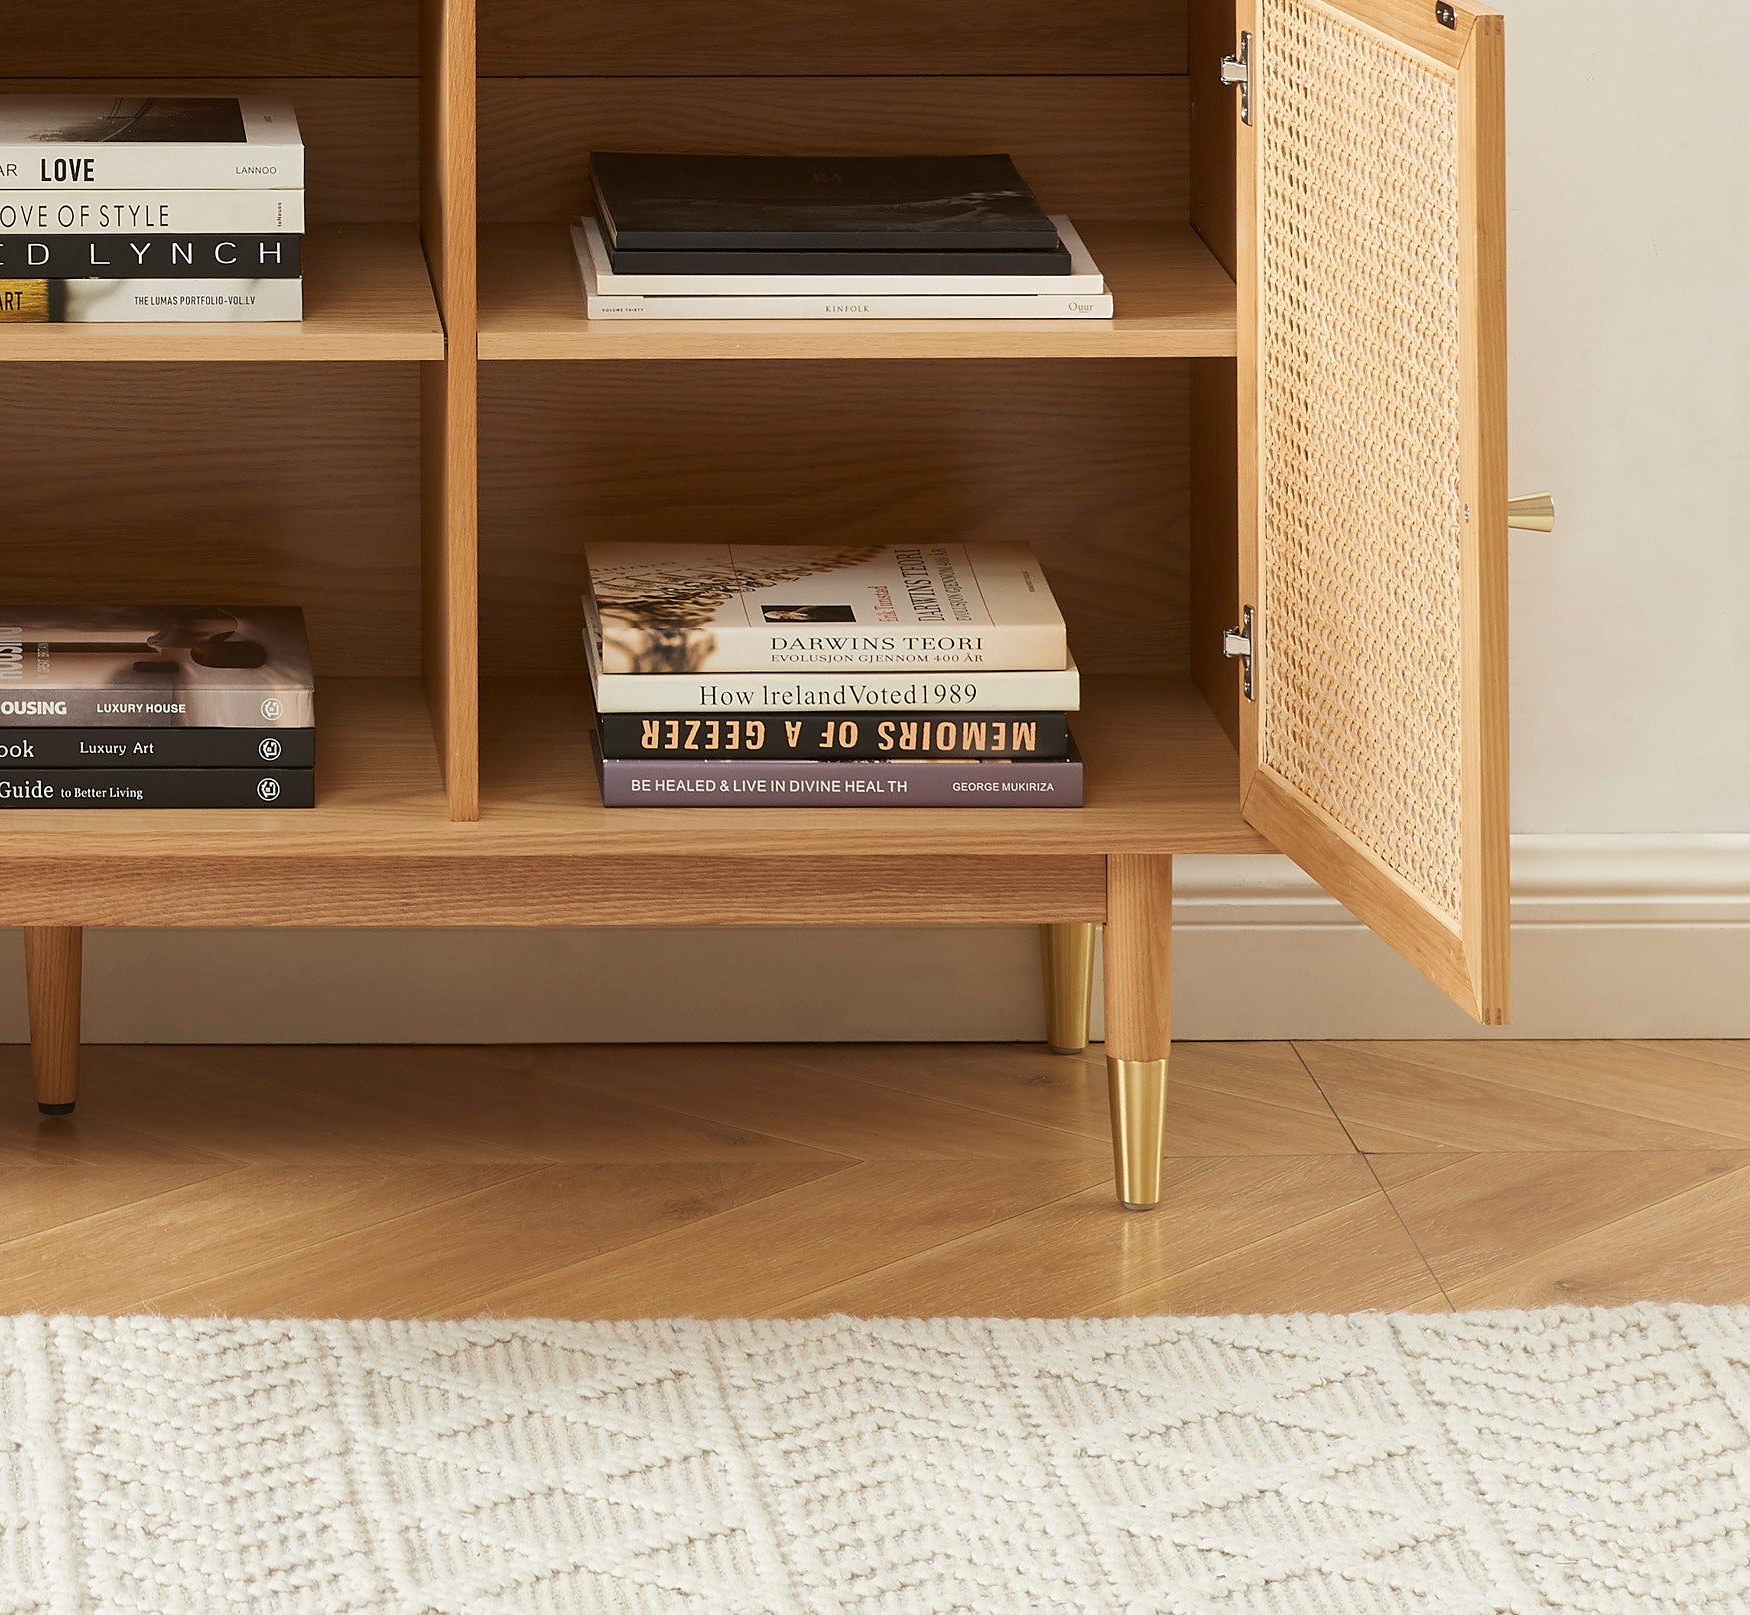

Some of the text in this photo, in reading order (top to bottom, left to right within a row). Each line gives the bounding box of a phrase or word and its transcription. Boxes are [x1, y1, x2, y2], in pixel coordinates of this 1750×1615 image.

[41, 158, 95, 182] LOVE
[235, 166, 277, 175] LANNOO
[57, 204, 90, 228] OF
[99, 204, 169, 228] STYLE
[90, 241, 281, 265] LYNCH
[134, 296, 149, 306] THE
[150, 296, 178, 306] LUMAS
[1068, 302, 1094, 311] Ouur
[825, 305, 869, 313] KINFOLK
[894, 548, 946, 622] DARWINS TEORI
[772, 637, 983, 651] DARWINS TEORI
[771, 652, 983, 663] EVOLUSJON GJENNOM 400 ÅR
[700, 685, 755, 706] How
[96, 703, 144, 713] LUXURY
[145, 703, 187, 714] HOUSE
[641, 719, 1036, 751] MEMOIRS OF A GEEZER
[80, 741, 127, 756] Luxury
[132, 741, 154, 754] Art
[631, 779, 652, 792] BE
[655, 779, 716, 792] HEALED
[719, 779, 730, 792] &
[733, 779, 767, 792] LIVE
[770, 780, 786, 792] IN
[789, 779, 841, 793] DIVINE
[952, 782, 1000, 792] GEORGE
[1001, 782, 1055, 792] MUKIRIZA
[60, 788, 72, 798] to
[74, 787, 108, 798] Better
[109, 787, 144, 800] Living
